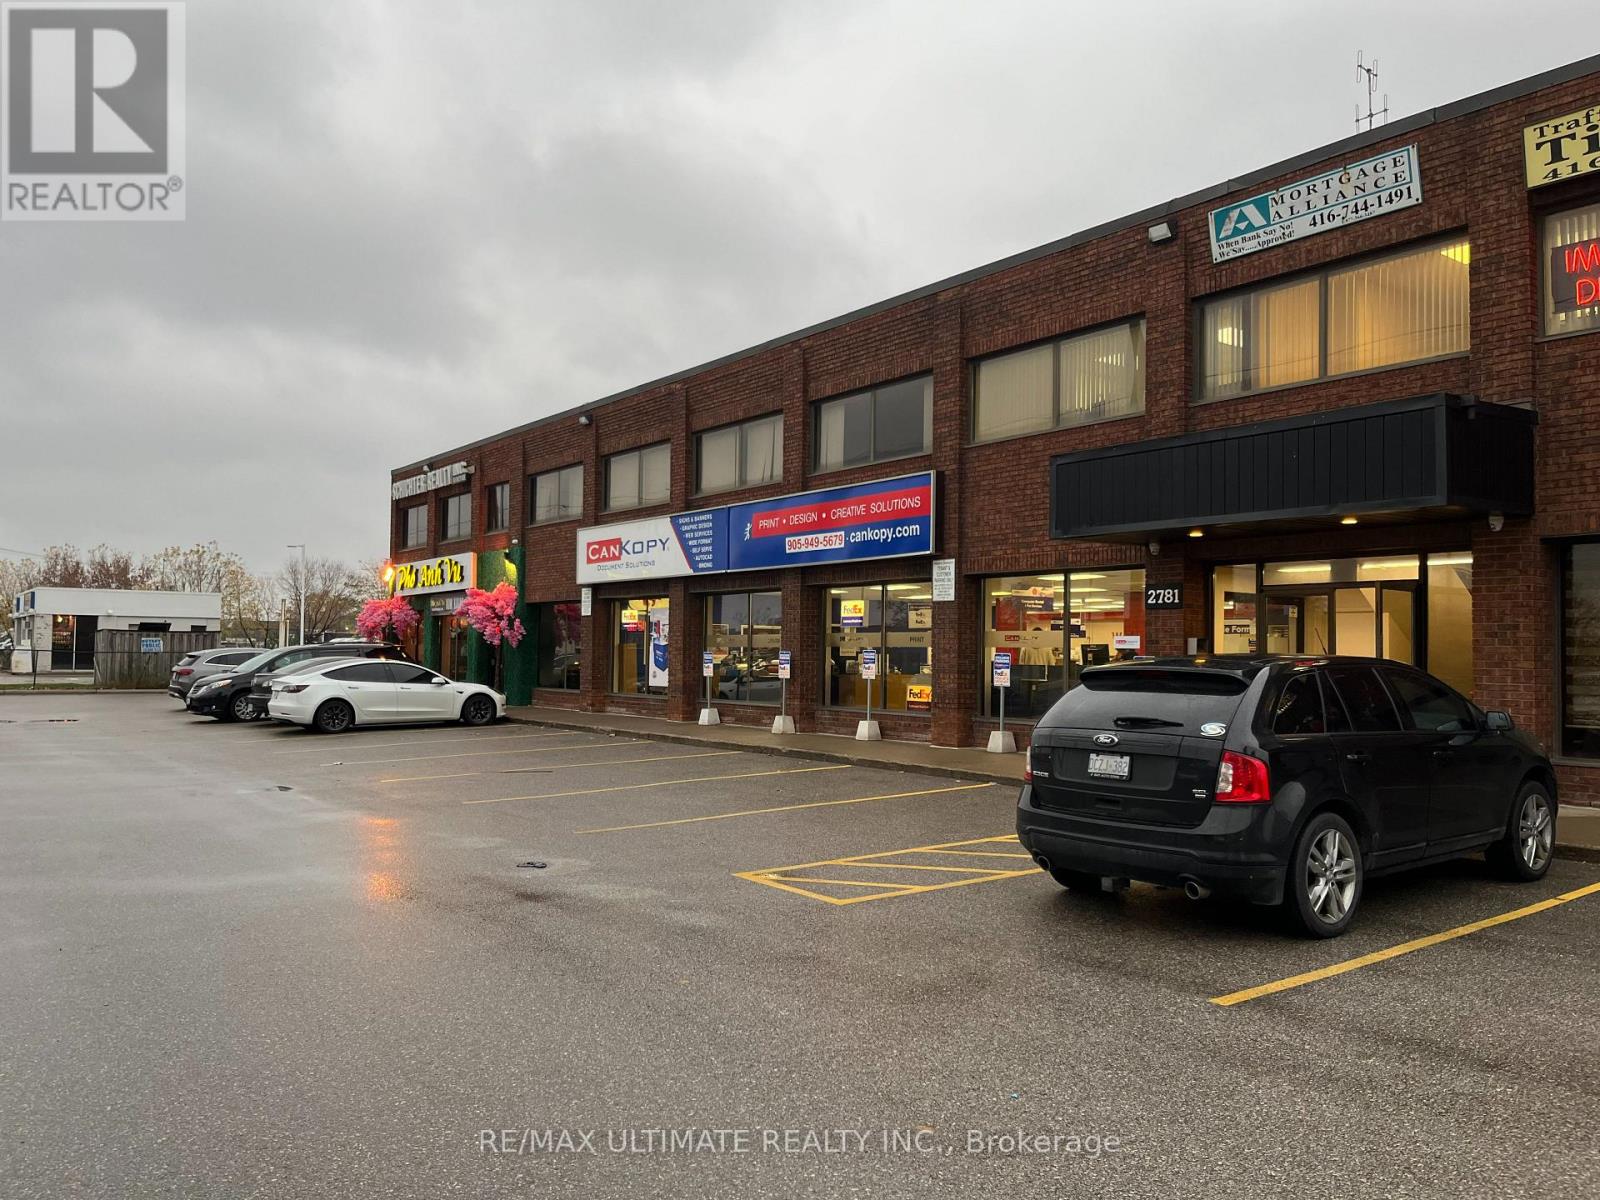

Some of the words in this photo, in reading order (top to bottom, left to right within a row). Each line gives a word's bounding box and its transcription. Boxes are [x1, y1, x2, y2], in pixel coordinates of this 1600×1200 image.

[1533, 108, 1600, 139] Traf
[1270, 155, 1405, 207] MORTGAGE
[1272, 170, 1406, 224] ALLIANCE
[1308, 186, 1413, 228] 416-744-1491
[1218, 239, 1239, 251] When
[1241, 233, 1261, 243] Bank
[1263, 228, 1276, 238] Say
[1280, 221, 1293, 232] No!
[1218, 251, 1230, 259] We
[1576, 278, 1600, 305] D
[759, 517, 779, 529] PRINT
[789, 512, 818, 524] DESIGN
[831, 504, 866, 519] CREATIVE
[870, 496, 921, 514] SOLUTIONS
[694, 530, 712, 538] SERVICES
[787, 534, 844, 550] 905-949-5679
[850, 524, 920, 545] cankopy.com
[588, 537, 670, 560] CANKOPY
[418, 559, 442, 587] Anh
[597, 563, 624, 571] DOCUMENT
[626, 560, 656, 569] SOLUTIONS
[1147, 589, 1179, 604] 2781
[843, 605, 862, 615] FedEx
[909, 688, 932, 699] FedEx
